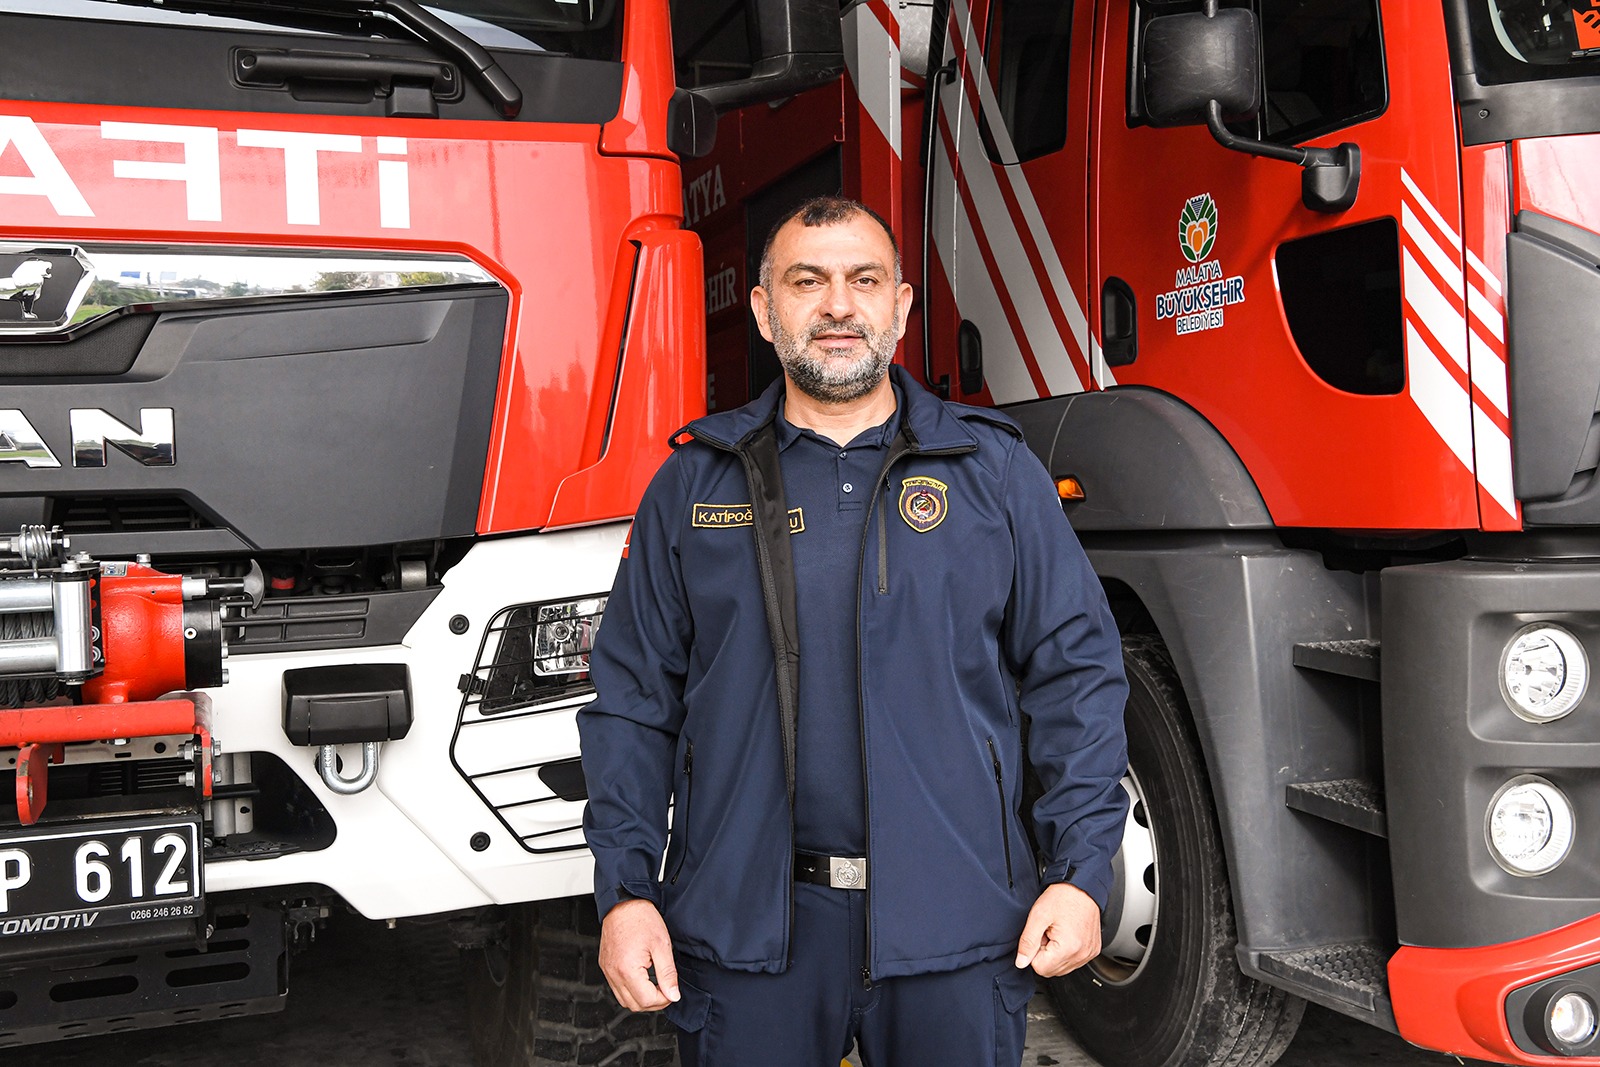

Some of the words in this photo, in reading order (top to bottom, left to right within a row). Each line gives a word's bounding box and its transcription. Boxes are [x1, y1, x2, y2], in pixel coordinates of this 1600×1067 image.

[1176, 262, 1221, 287] MALATYA
[75, 832, 189, 903] 612
[130, 910, 152, 921] 0266
[153, 907, 169, 918] 246
[170, 906, 182, 917] 26
[183, 905, 194, 915] 62
